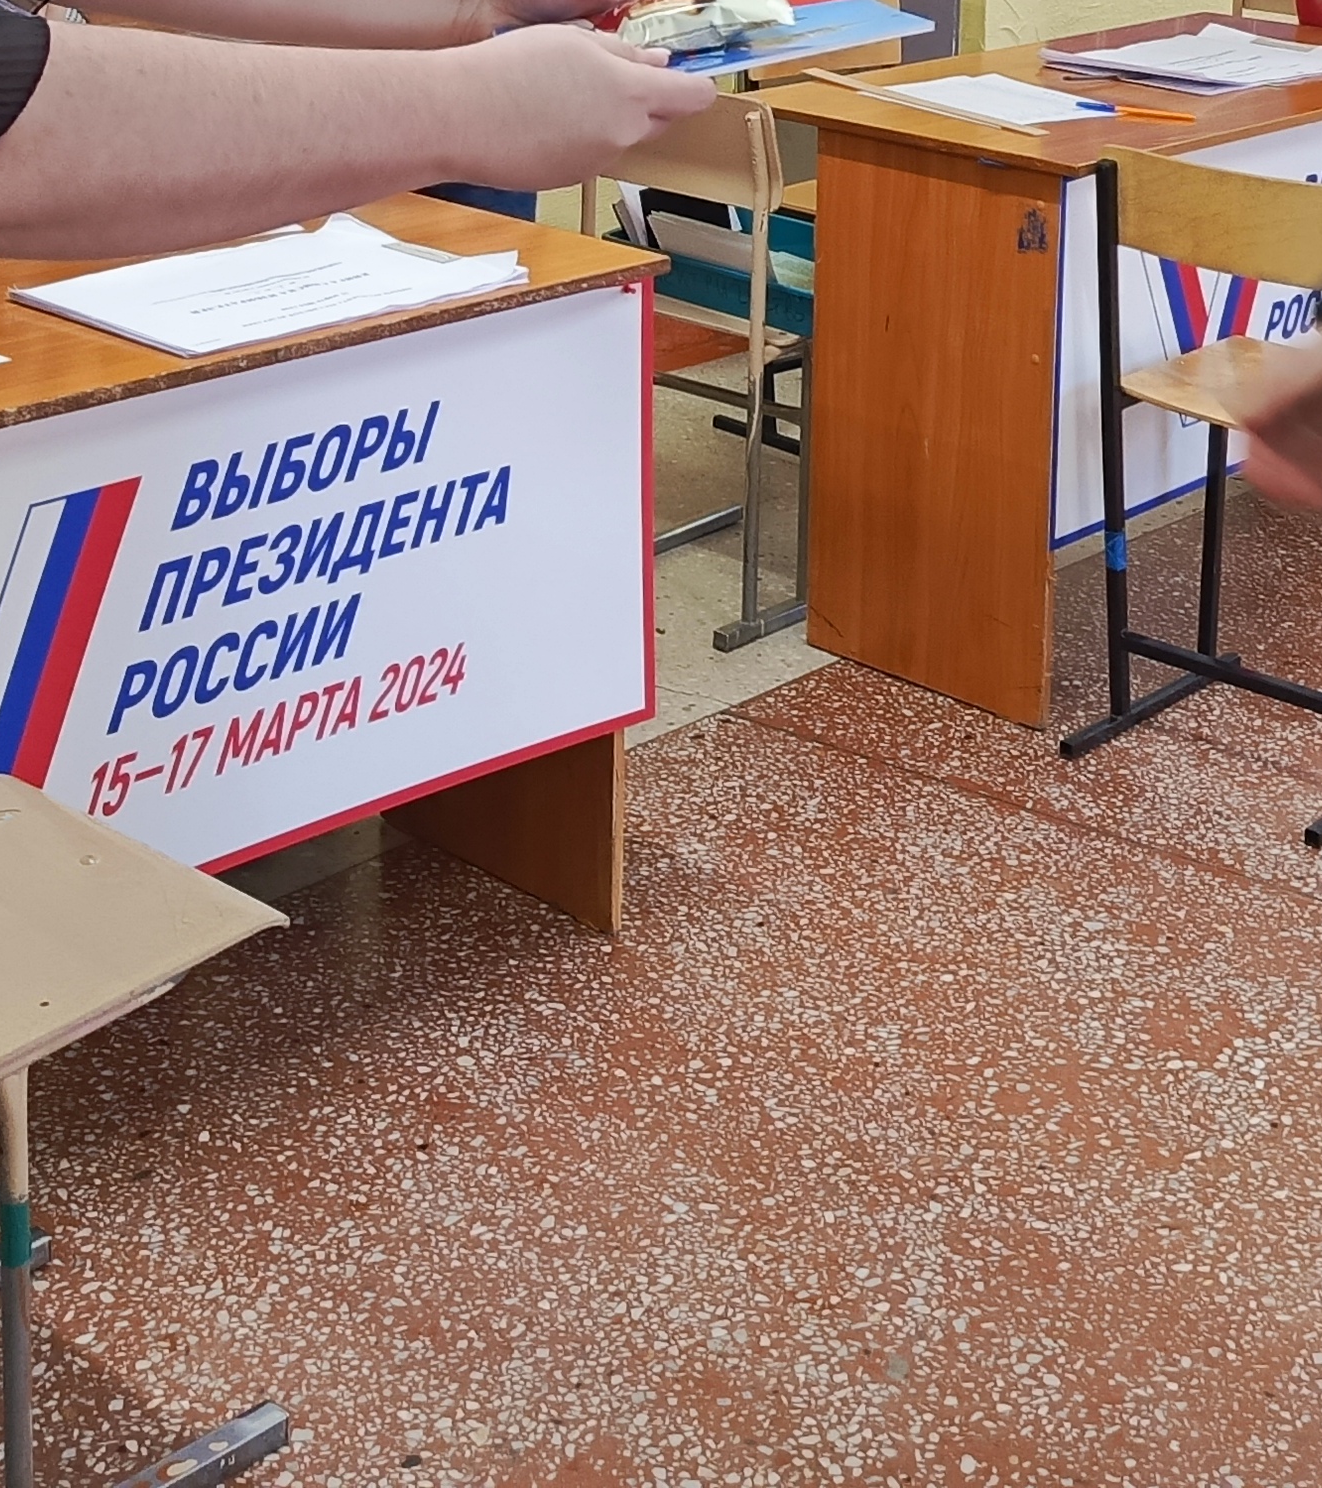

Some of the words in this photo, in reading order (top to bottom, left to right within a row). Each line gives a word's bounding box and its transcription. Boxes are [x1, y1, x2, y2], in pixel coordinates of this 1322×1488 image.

[170, 400, 441, 531] ВЫБОРЫ
[138, 465, 511, 632] ПРЕЗИДЕНТА
[105, 592, 362, 736] РОССИИ
[215, 675, 362, 776] МАРТА
[368, 641, 468, 723] 2024
